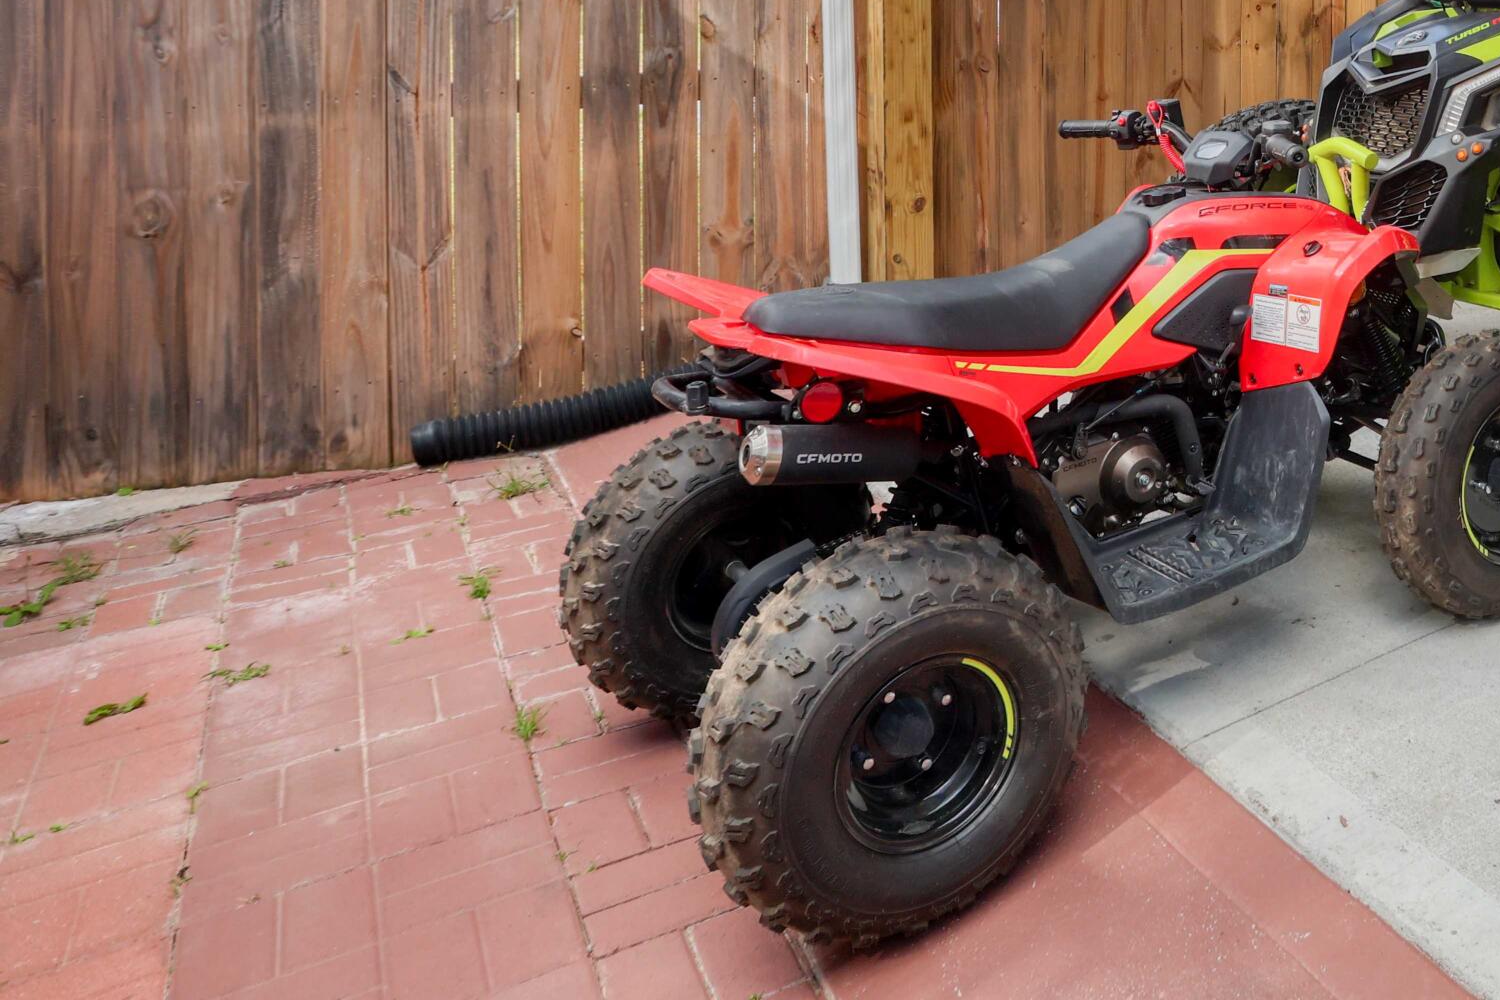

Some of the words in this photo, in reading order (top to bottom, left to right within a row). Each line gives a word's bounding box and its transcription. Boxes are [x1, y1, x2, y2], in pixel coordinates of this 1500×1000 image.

[1445, 21, 1490, 45] TURBO
[796, 453, 863, 465] CFMOTO
[1062, 457, 1098, 472] CFMOTO
